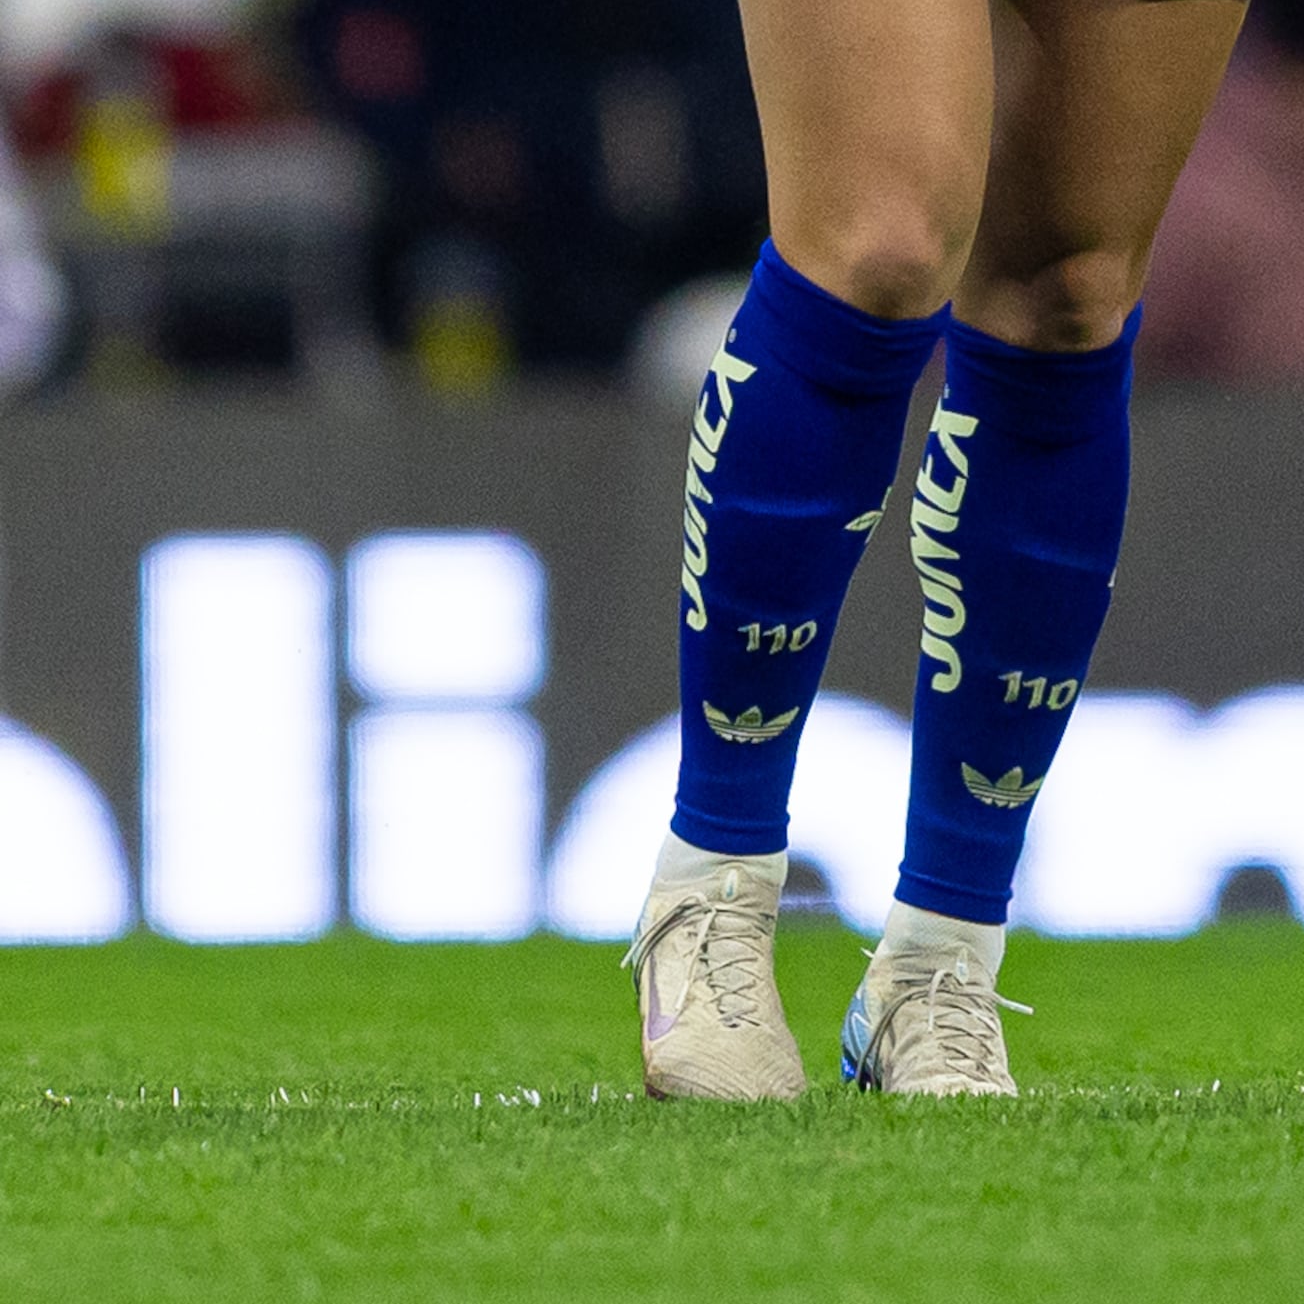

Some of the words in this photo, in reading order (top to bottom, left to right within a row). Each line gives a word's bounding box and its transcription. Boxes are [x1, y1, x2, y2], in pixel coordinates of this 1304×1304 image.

[680, 346, 758, 632] JUMEX
[909, 394, 979, 694] JUMEX
[737, 620, 819, 655] 110
[998, 670, 1079, 711] 110
